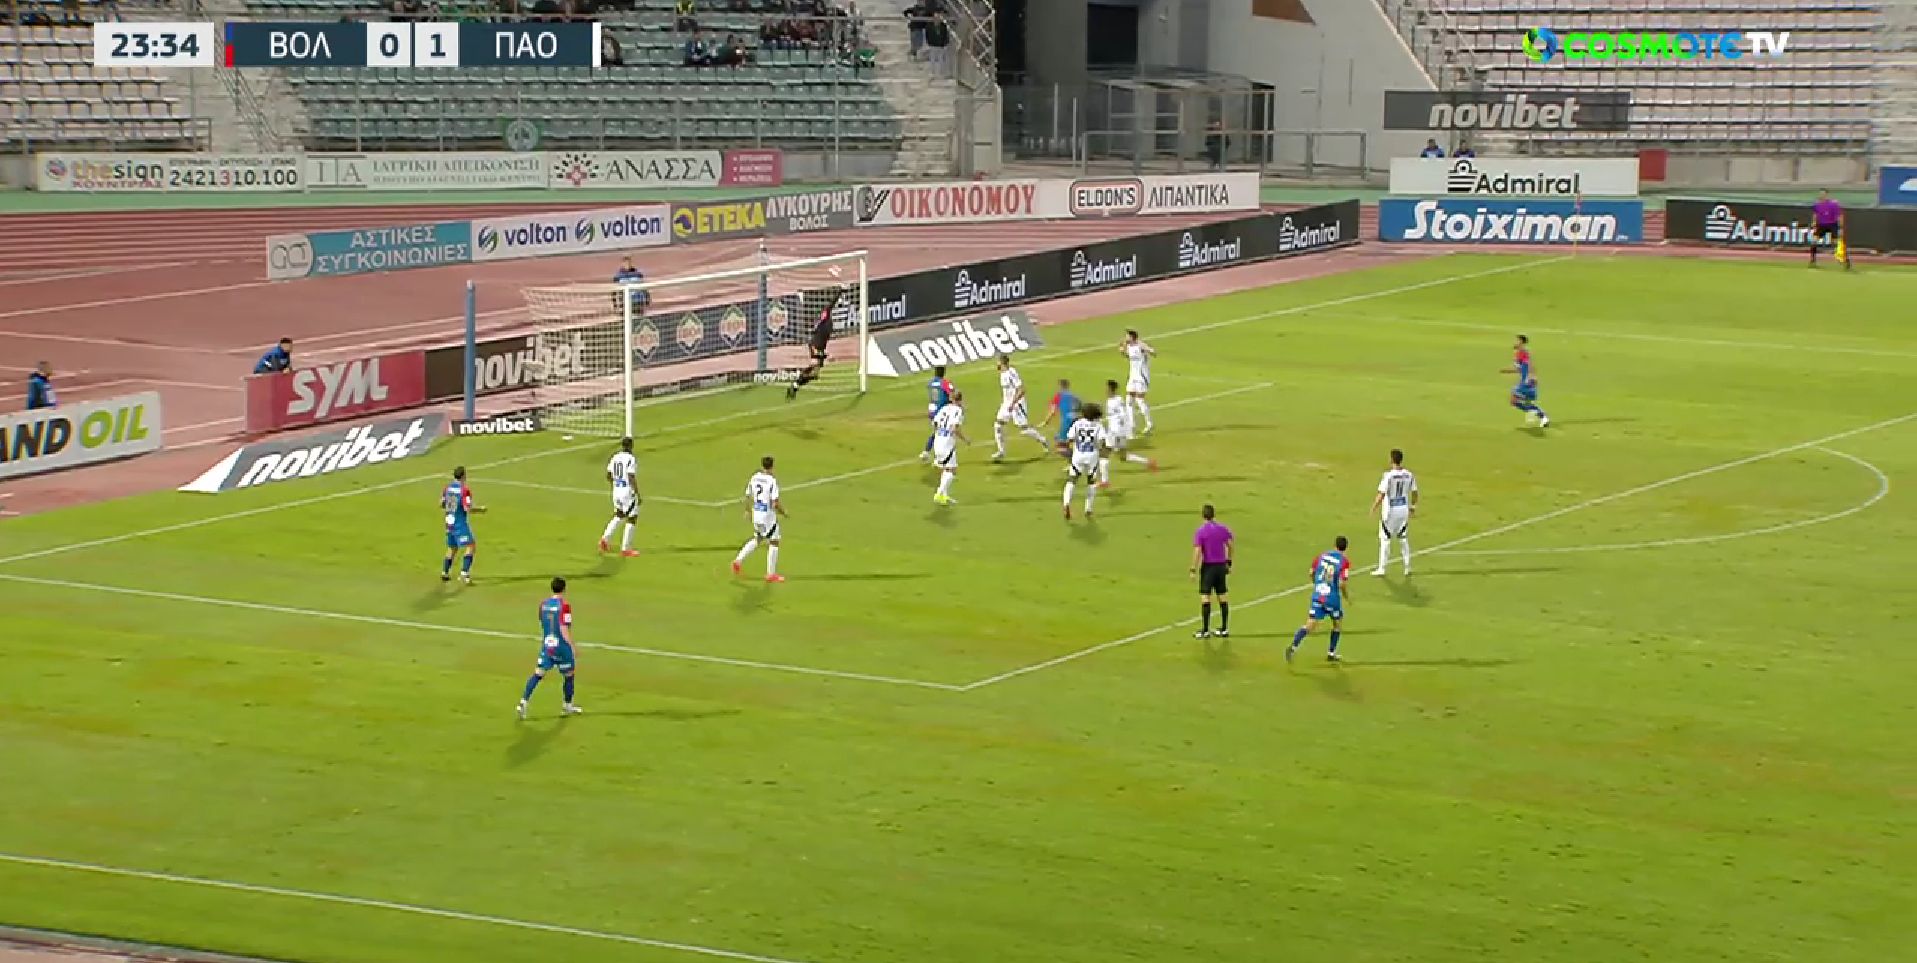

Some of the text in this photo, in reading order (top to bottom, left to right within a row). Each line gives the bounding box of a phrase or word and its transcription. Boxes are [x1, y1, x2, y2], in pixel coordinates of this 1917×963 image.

[1429, 94, 1580, 128] novibet
[169, 170, 298, 186] 2421310.100
[1475, 173, 1581, 194] Admiral
[766, 190, 852, 219] ΛΥΚΟΥΡΗΣ
[890, 184, 1035, 219] ΟΙΚΟΝΟΜΟΥ
[1077, 187, 1136, 207] ELDON'S
[1149, 184, 1230, 208] ΛΙΠΑΝΤΙΚΑ
[504, 215, 662, 246] volton volton
[789, 214, 829, 231] ΒΟΛΟΣ
[1292, 220, 1341, 249] Admiral
[1403, 201, 1618, 240] Stoiximan
[351, 225, 437, 249] ΑΣΤΙΚΕΣ
[1191, 236, 1241, 267] Admiral
[316, 243, 468, 273] ΣΥΓΚΟΙΝΩΝΙΕΣ
[1084, 253, 1137, 286] Admiral
[970, 274, 1027, 306] Admiral
[898, 314, 1030, 373] novibet
[287, 358, 389, 419] SYM
[80, 403, 149, 449] OIL
[460, 418, 534, 434] novibet
[1078, 427, 1095, 442] 55
[236, 418, 425, 488] novibet
[756, 483, 764, 503] 2
